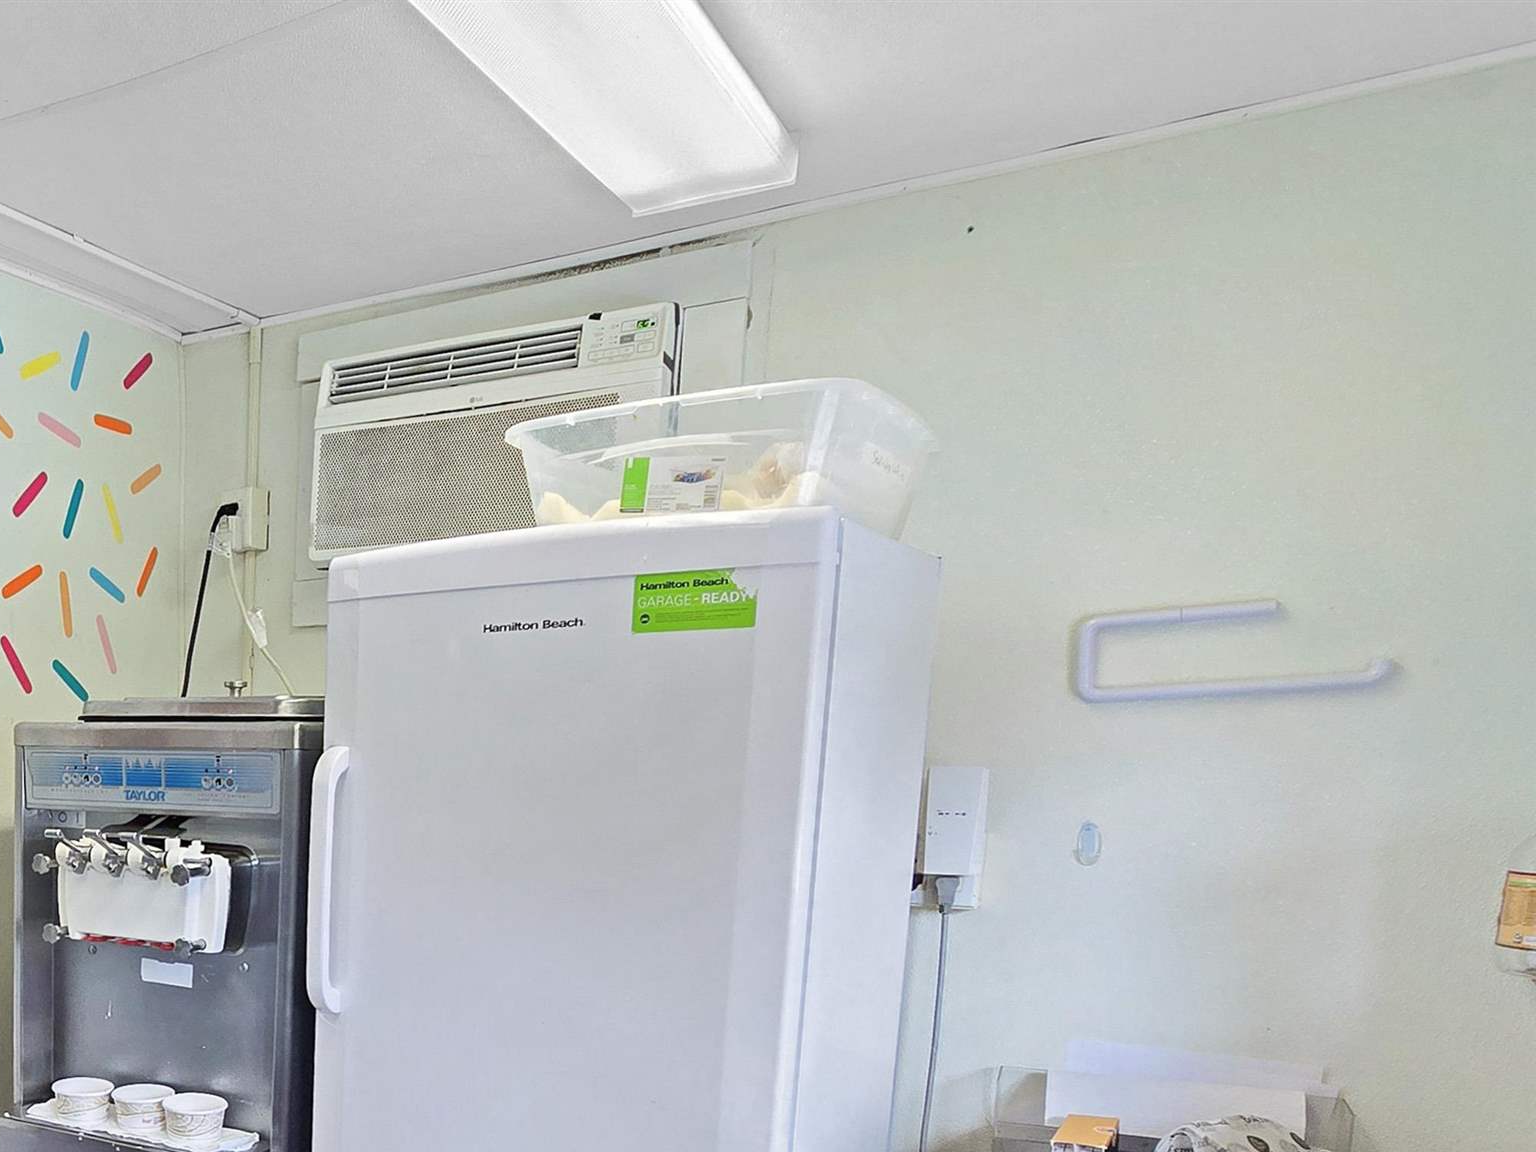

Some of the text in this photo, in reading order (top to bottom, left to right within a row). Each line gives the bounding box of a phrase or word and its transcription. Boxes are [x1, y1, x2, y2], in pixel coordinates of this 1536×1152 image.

[640, 577, 729, 591] Hamilton Beach
[482, 617, 583, 633] Hamilton Beach
[124, 789, 165, 802] TAYLOR
